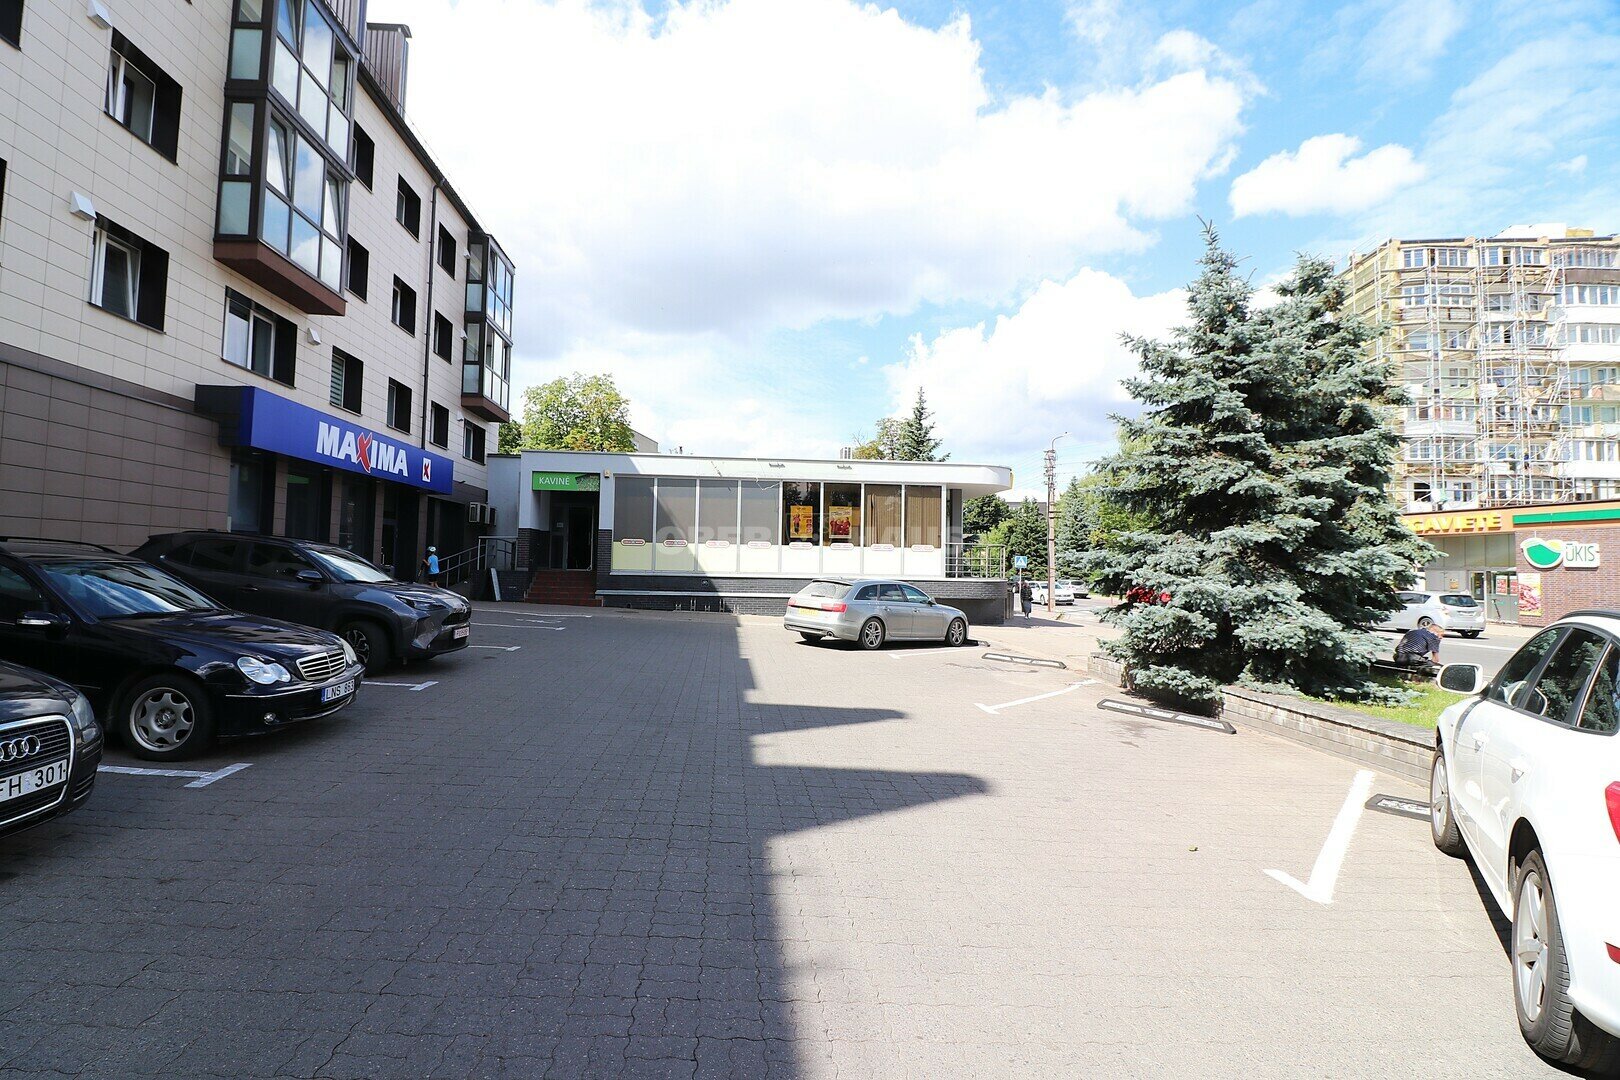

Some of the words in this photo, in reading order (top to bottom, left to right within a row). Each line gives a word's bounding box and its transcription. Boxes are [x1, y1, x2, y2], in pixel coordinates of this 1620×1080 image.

[316, 421, 408, 478] MAXIMA
[539, 476, 570, 486] KAVINĖ
[1566, 543, 1595, 561] ŪKIS
[325, 685, 341, 700] LNS
[34, 762, 63, 788] 301
